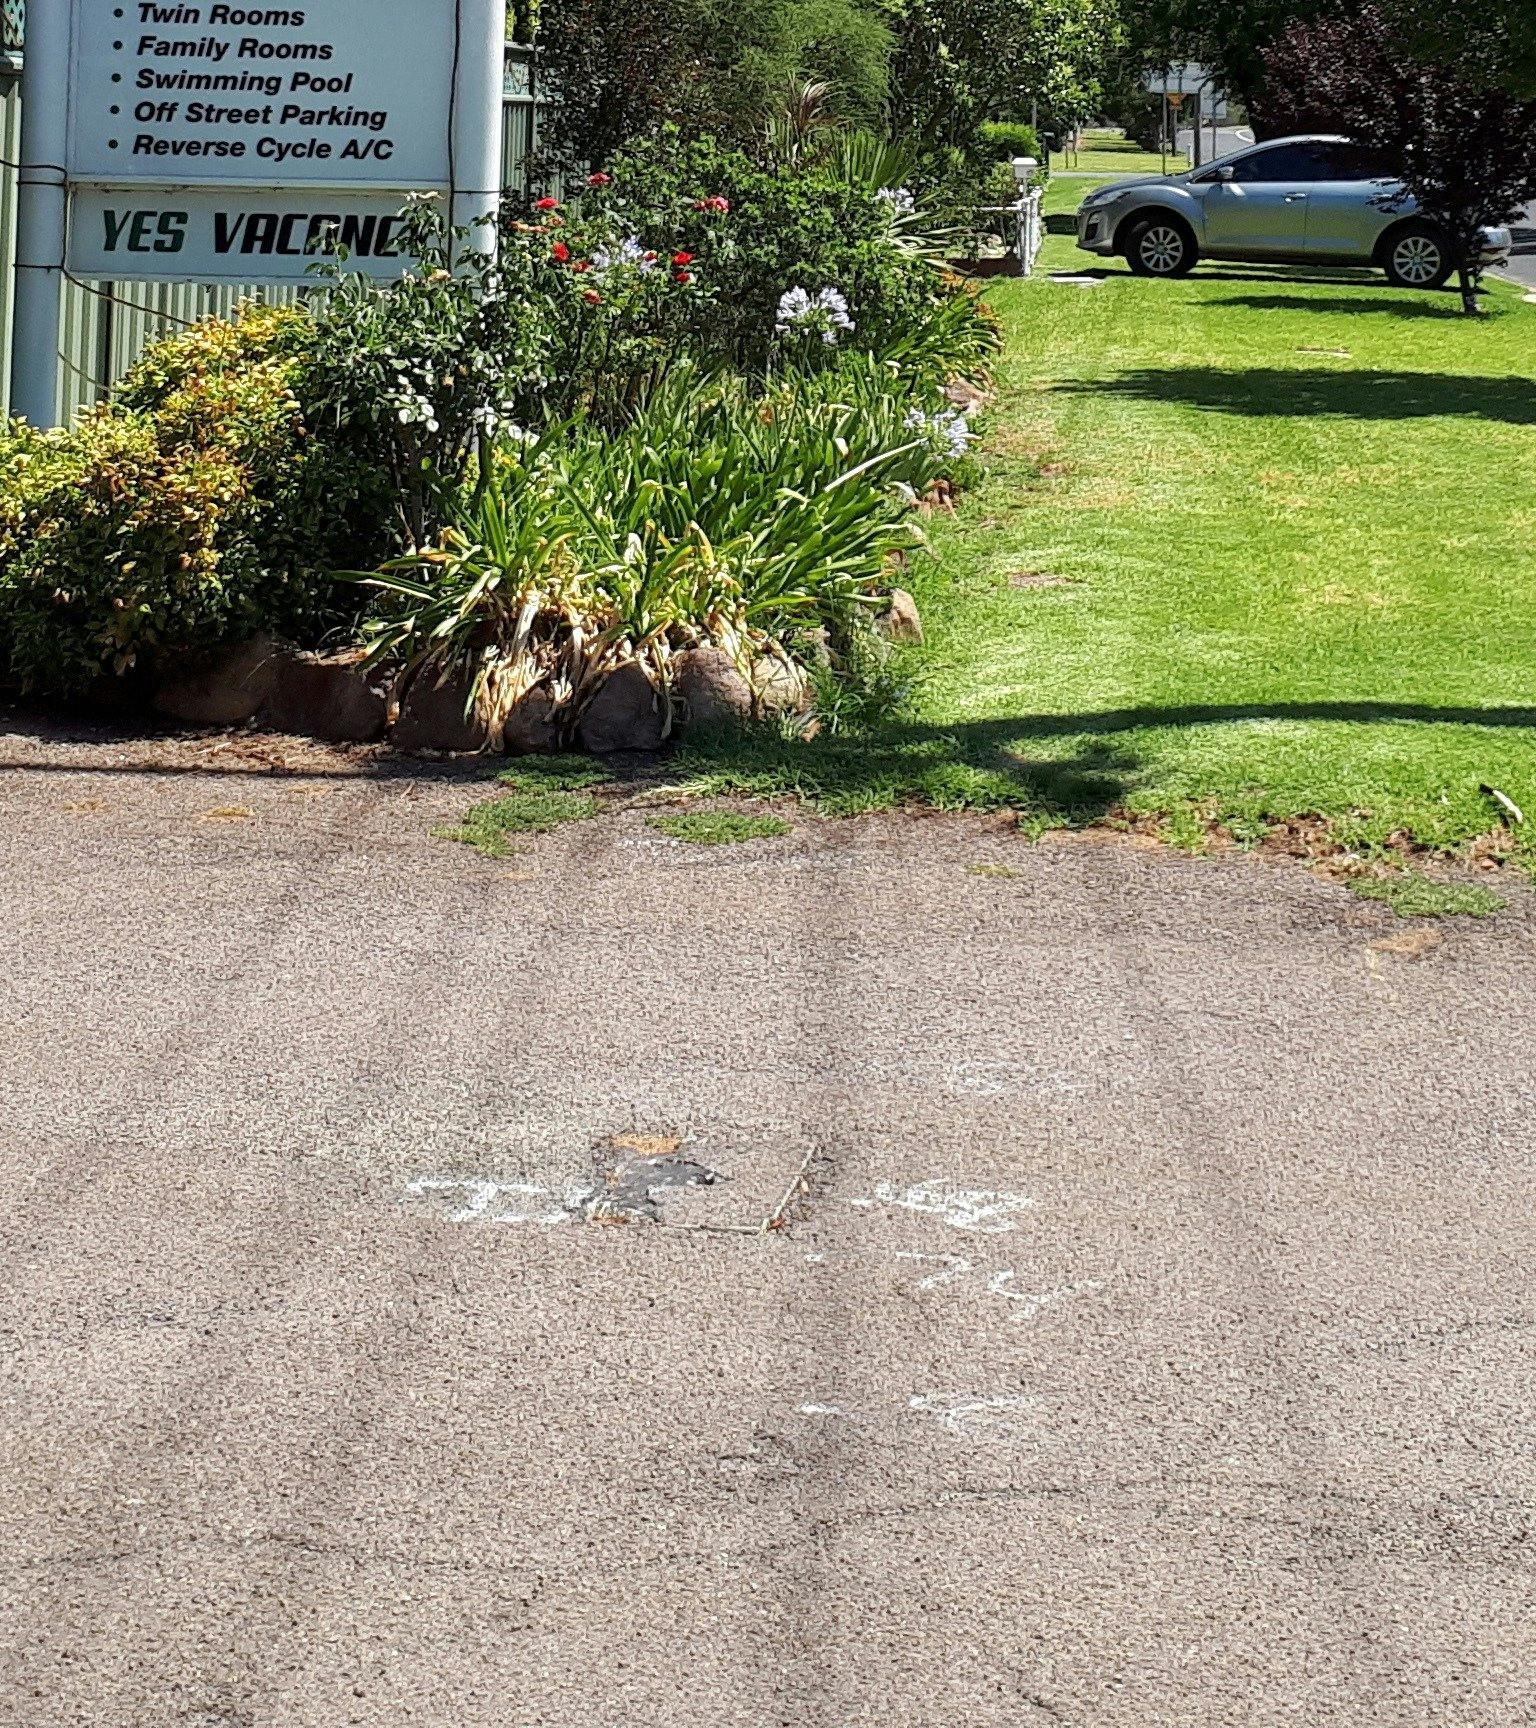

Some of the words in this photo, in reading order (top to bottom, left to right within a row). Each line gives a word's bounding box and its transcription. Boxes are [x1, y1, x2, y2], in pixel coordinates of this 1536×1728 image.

[139, 3, 200, 24] Twin
[209, 5, 305, 27] Rooms
[136, 36, 229, 61] Family
[238, 39, 333, 60] Rooms
[136, 69, 282, 96] Swimming
[290, 72, 353, 93] Pool
[134, 102, 177, 123] Off
[185, 102, 273, 125] Street
[280, 105, 387, 130] Parking
[132, 135, 246, 157] Reverse
[256, 137, 332, 162] Cycle
[341, 138, 393, 159] A/C
[103, 210, 188, 252] YES
